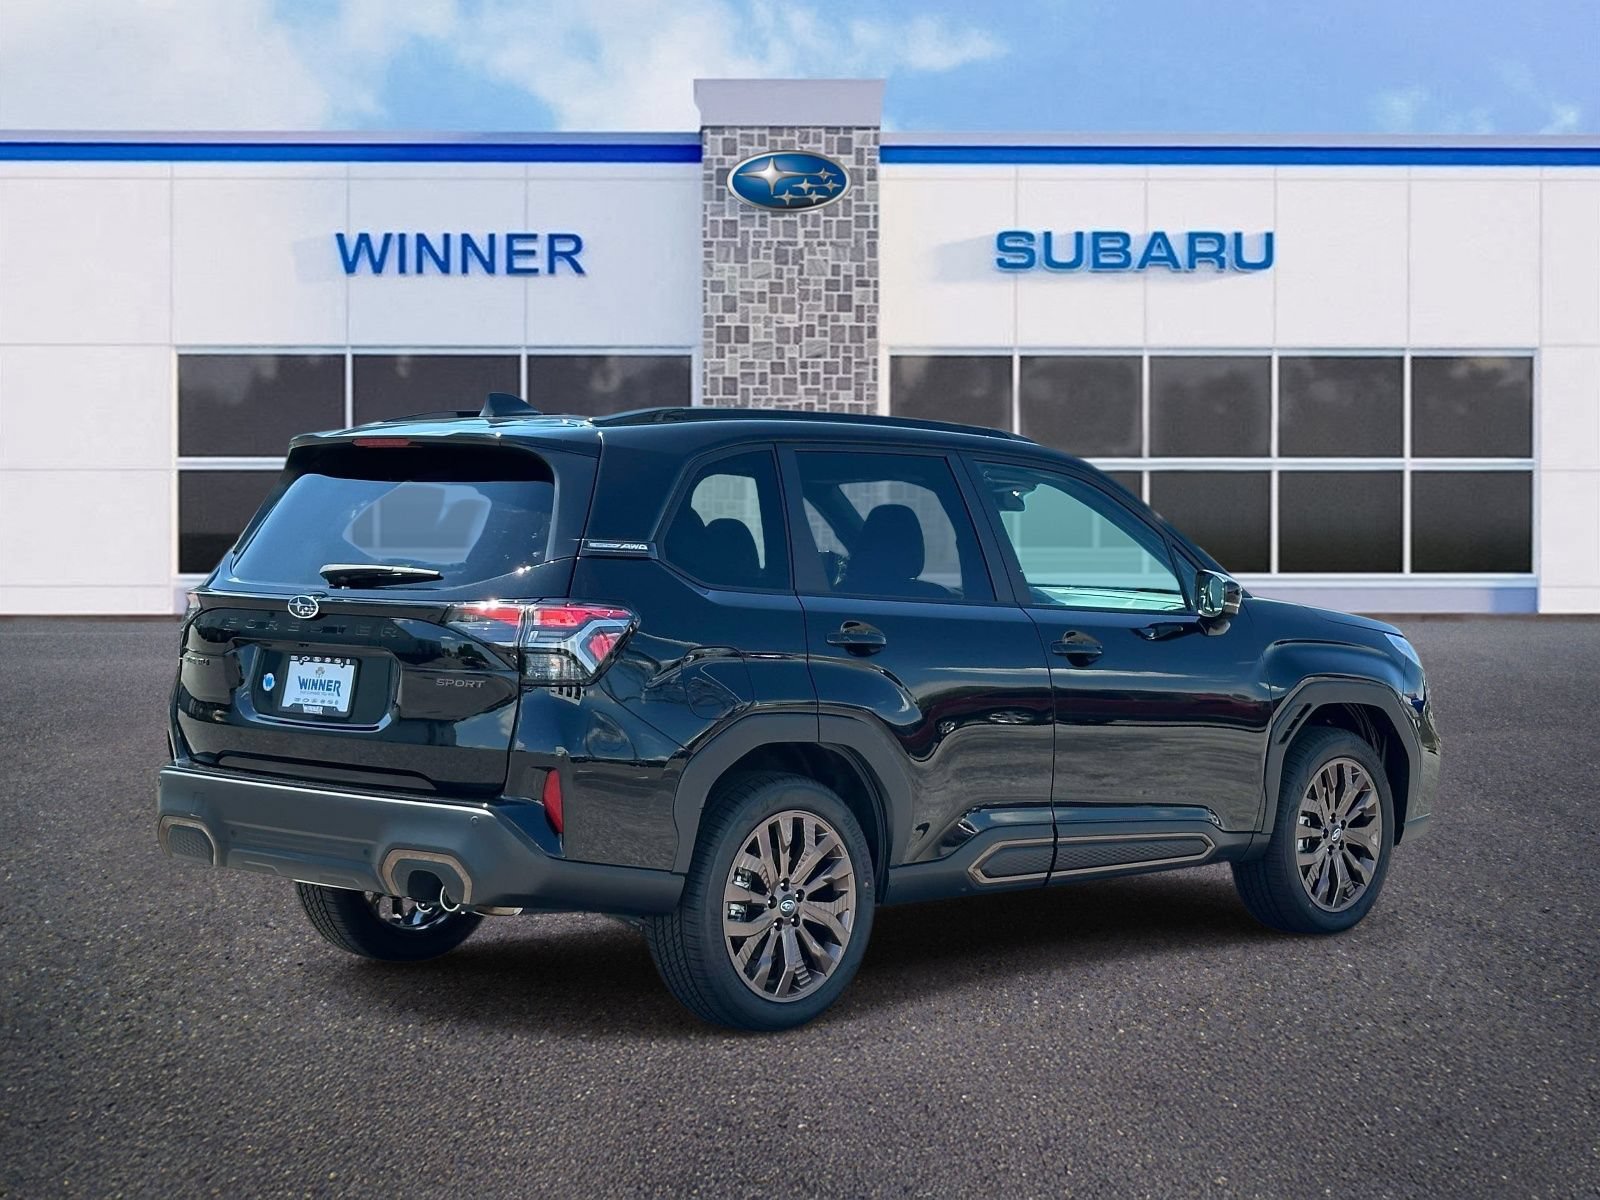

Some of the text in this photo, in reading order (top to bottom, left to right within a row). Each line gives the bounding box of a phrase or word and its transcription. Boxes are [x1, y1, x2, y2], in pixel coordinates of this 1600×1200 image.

[335, 232, 586, 275] WINNER
[996, 230, 1275, 271] SUBARU
[298, 676, 342, 697] WINNER
[436, 678, 486, 689] SPORT
